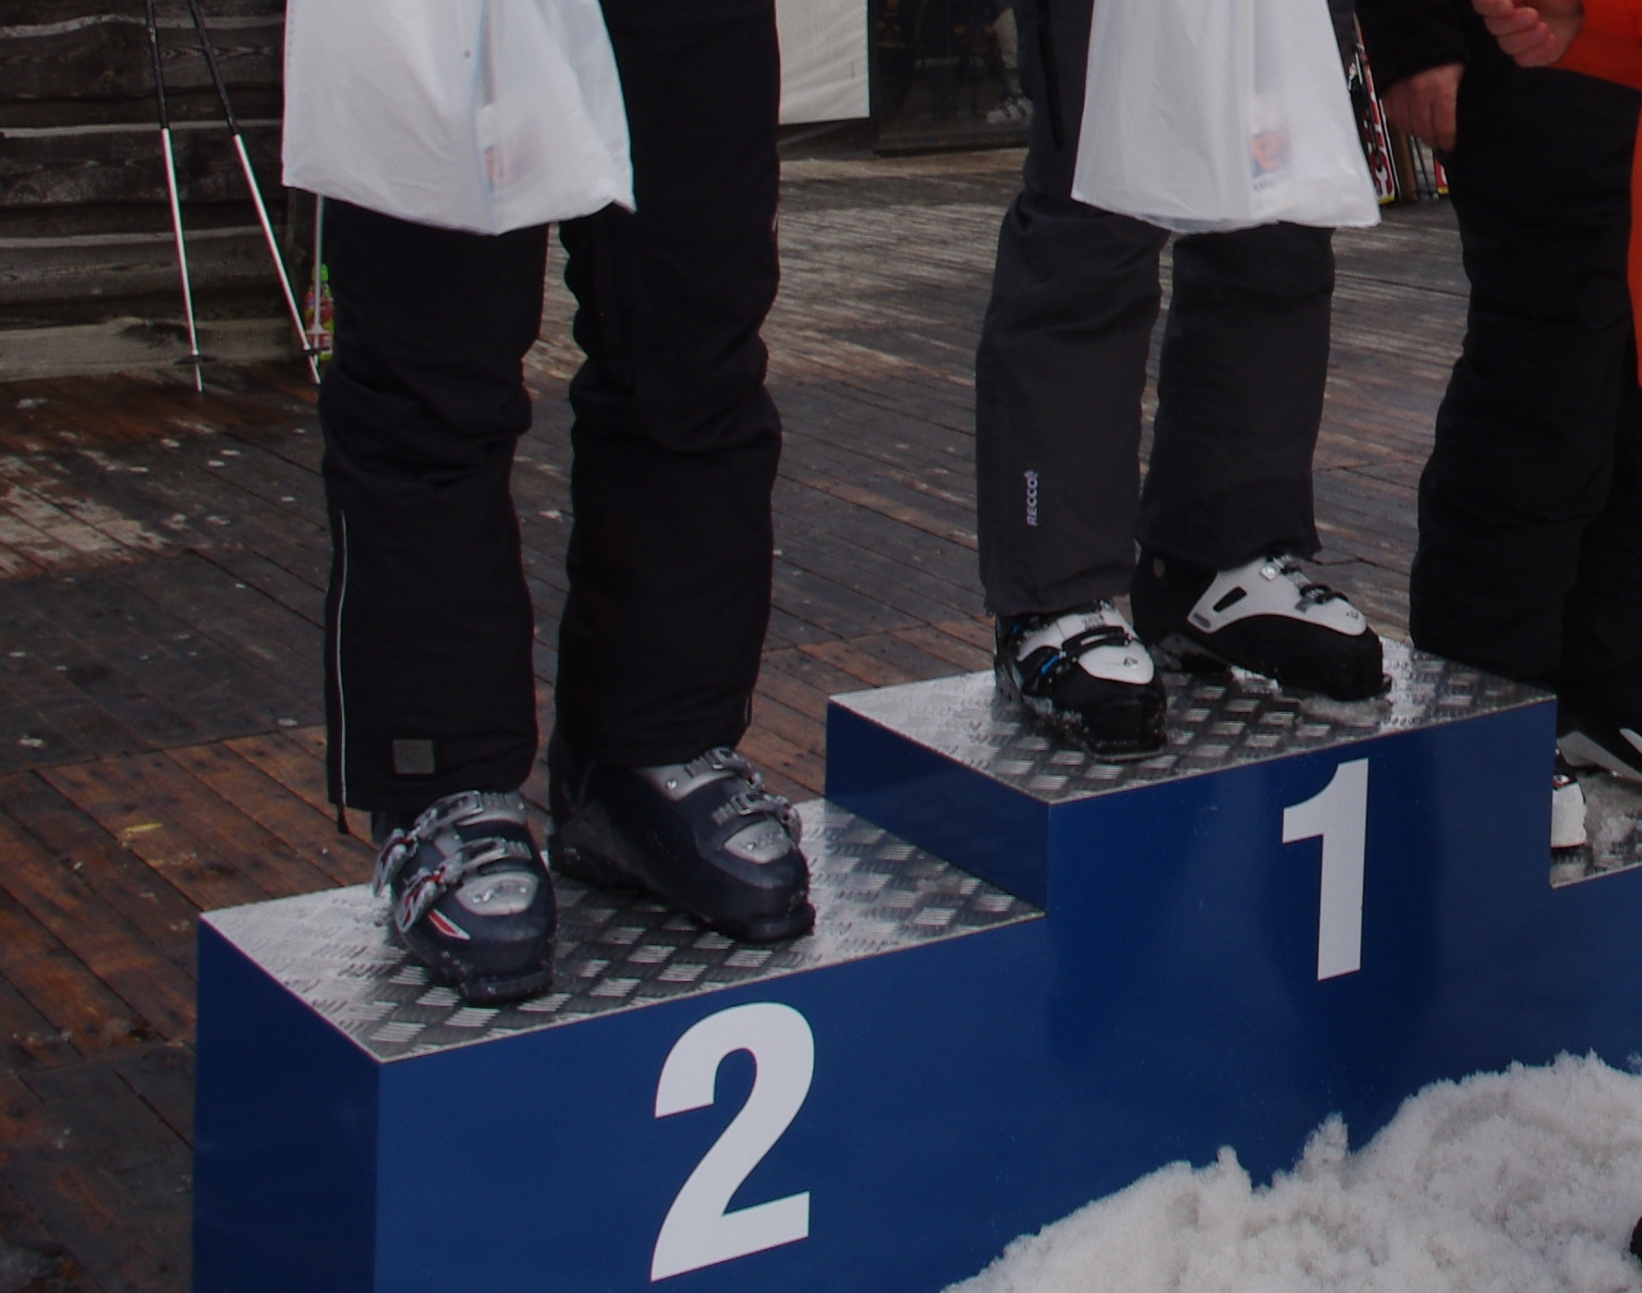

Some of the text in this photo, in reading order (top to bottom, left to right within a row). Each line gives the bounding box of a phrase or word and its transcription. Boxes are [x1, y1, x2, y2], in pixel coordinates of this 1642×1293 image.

[1026, 476, 1038, 527] RECCO
[1282, 758, 1369, 982] 1
[650, 1001, 815, 1282] 2
